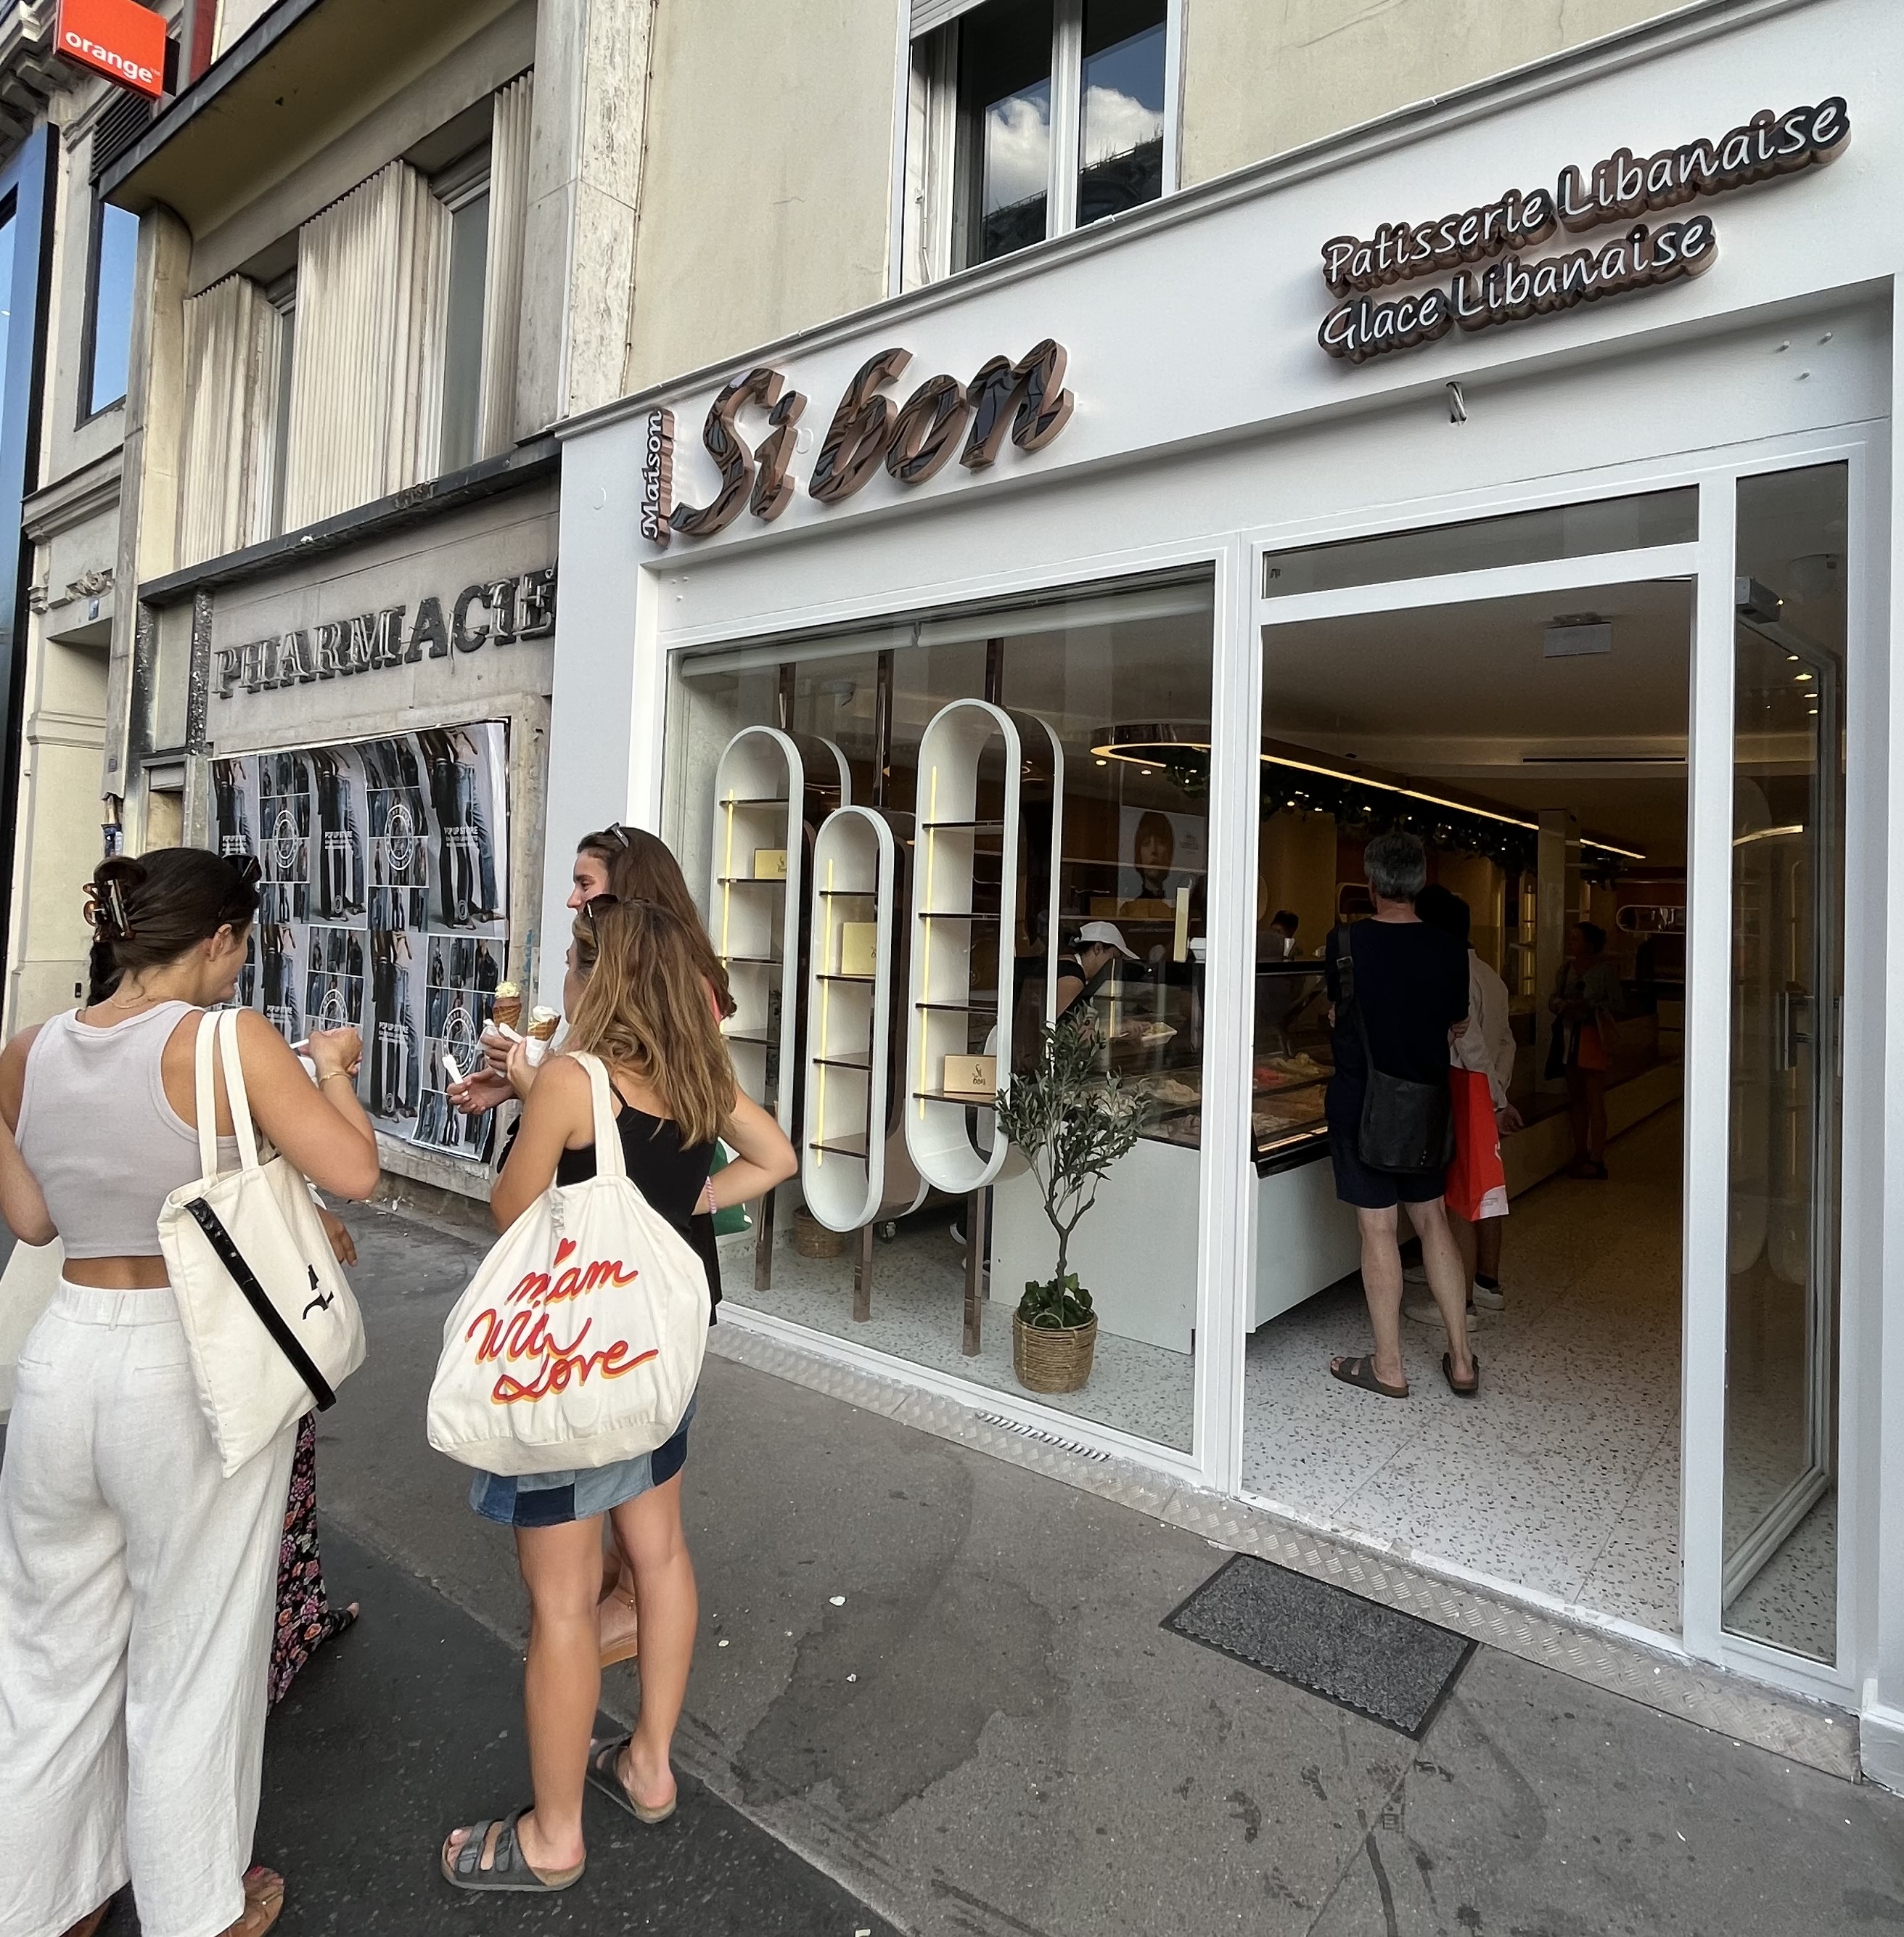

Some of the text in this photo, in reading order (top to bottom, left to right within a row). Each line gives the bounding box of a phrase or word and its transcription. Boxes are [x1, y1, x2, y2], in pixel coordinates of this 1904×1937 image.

[65, 31, 153, 83] orange
[1326, 104, 1843, 284] Patisserie Libanaise
[1322, 220, 1710, 351] Glace Libanaise
[641, 408, 665, 541] Maison
[668, 338, 1075, 536] Si bon
[210, 569, 557, 699] PHARMACIE
